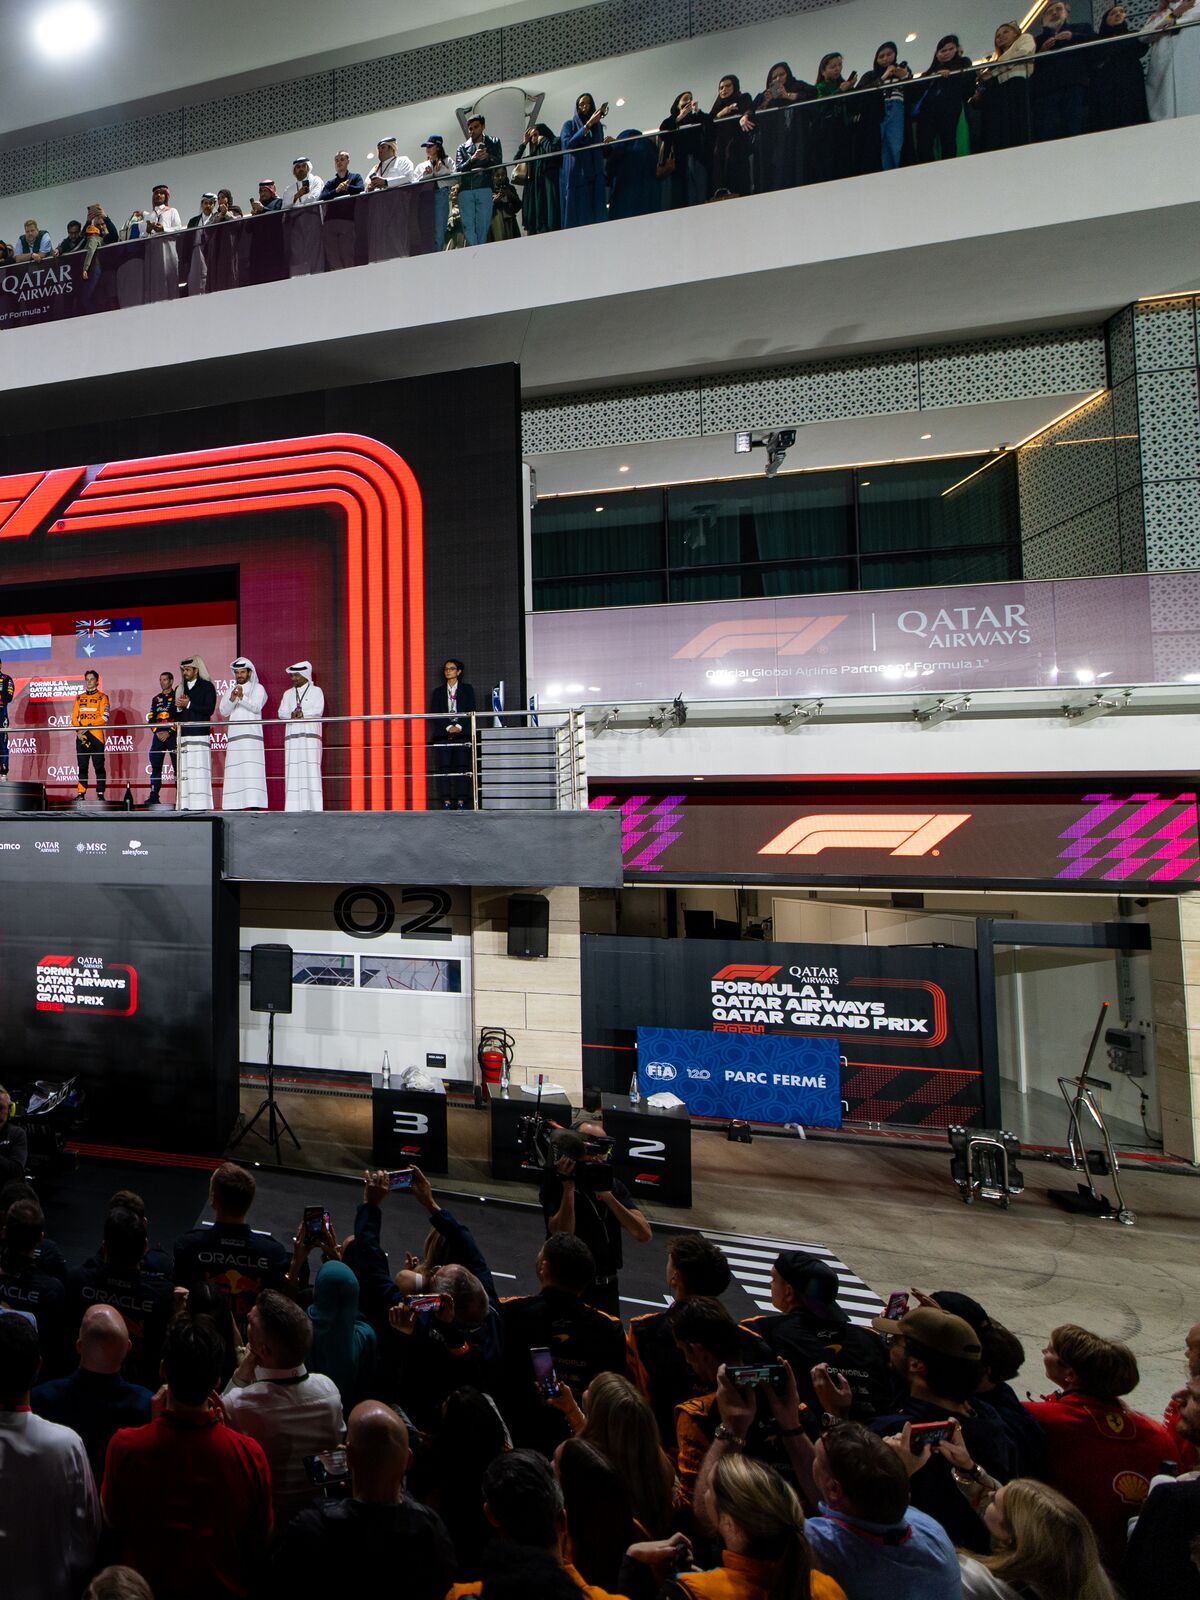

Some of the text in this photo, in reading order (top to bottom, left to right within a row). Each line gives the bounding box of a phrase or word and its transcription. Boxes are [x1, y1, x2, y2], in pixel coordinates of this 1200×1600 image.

[2, 265, 72, 295] QATAR
[17, 281, 73, 302] AIRWAYS
[0, 313, 8, 322] of
[9, 308, 41, 319] Formula
[897, 605, 1028, 637] QATAR
[928, 629, 1031, 648] AIRWAYS
[751, 667, 792, 677] Global
[795, 666, 838, 677] Airline
[913, 659, 973, 671] Formula
[7, 738, 36, 749] ATAR
[105, 736, 133, 745] ATAR
[48, 767, 79, 777] QATA
[757, 814, 972, 856] F1
[35, 841, 60, 850] QATAR
[333, 886, 452, 941] 02
[77, 956, 103, 965] QATAR
[36, 966, 100, 978] FORMULA 1
[789, 966, 839, 980] QATAR
[36, 975, 125, 989] QATAR AIRWAYS
[36, 984, 75, 994] QATAR
[711, 981, 833, 998] FORMULA 1
[800, 977, 840, 985] AIRWAYS
[36, 993, 104, 1006] GRAND PRIX
[712, 995, 885, 1015] QATAR AIRWAYS
[712, 1008, 929, 1033] QATAR GRAND PRIX
[724, 1070, 767, 1084] PARC
[773, 1073, 827, 1089] FERMÉ
[392, 1110, 428, 1134] 3
[629, 1137, 666, 1161] 2
[198, 1252, 269, 1269] ORACLE
[81, 1286, 153, 1312] ORACLE
